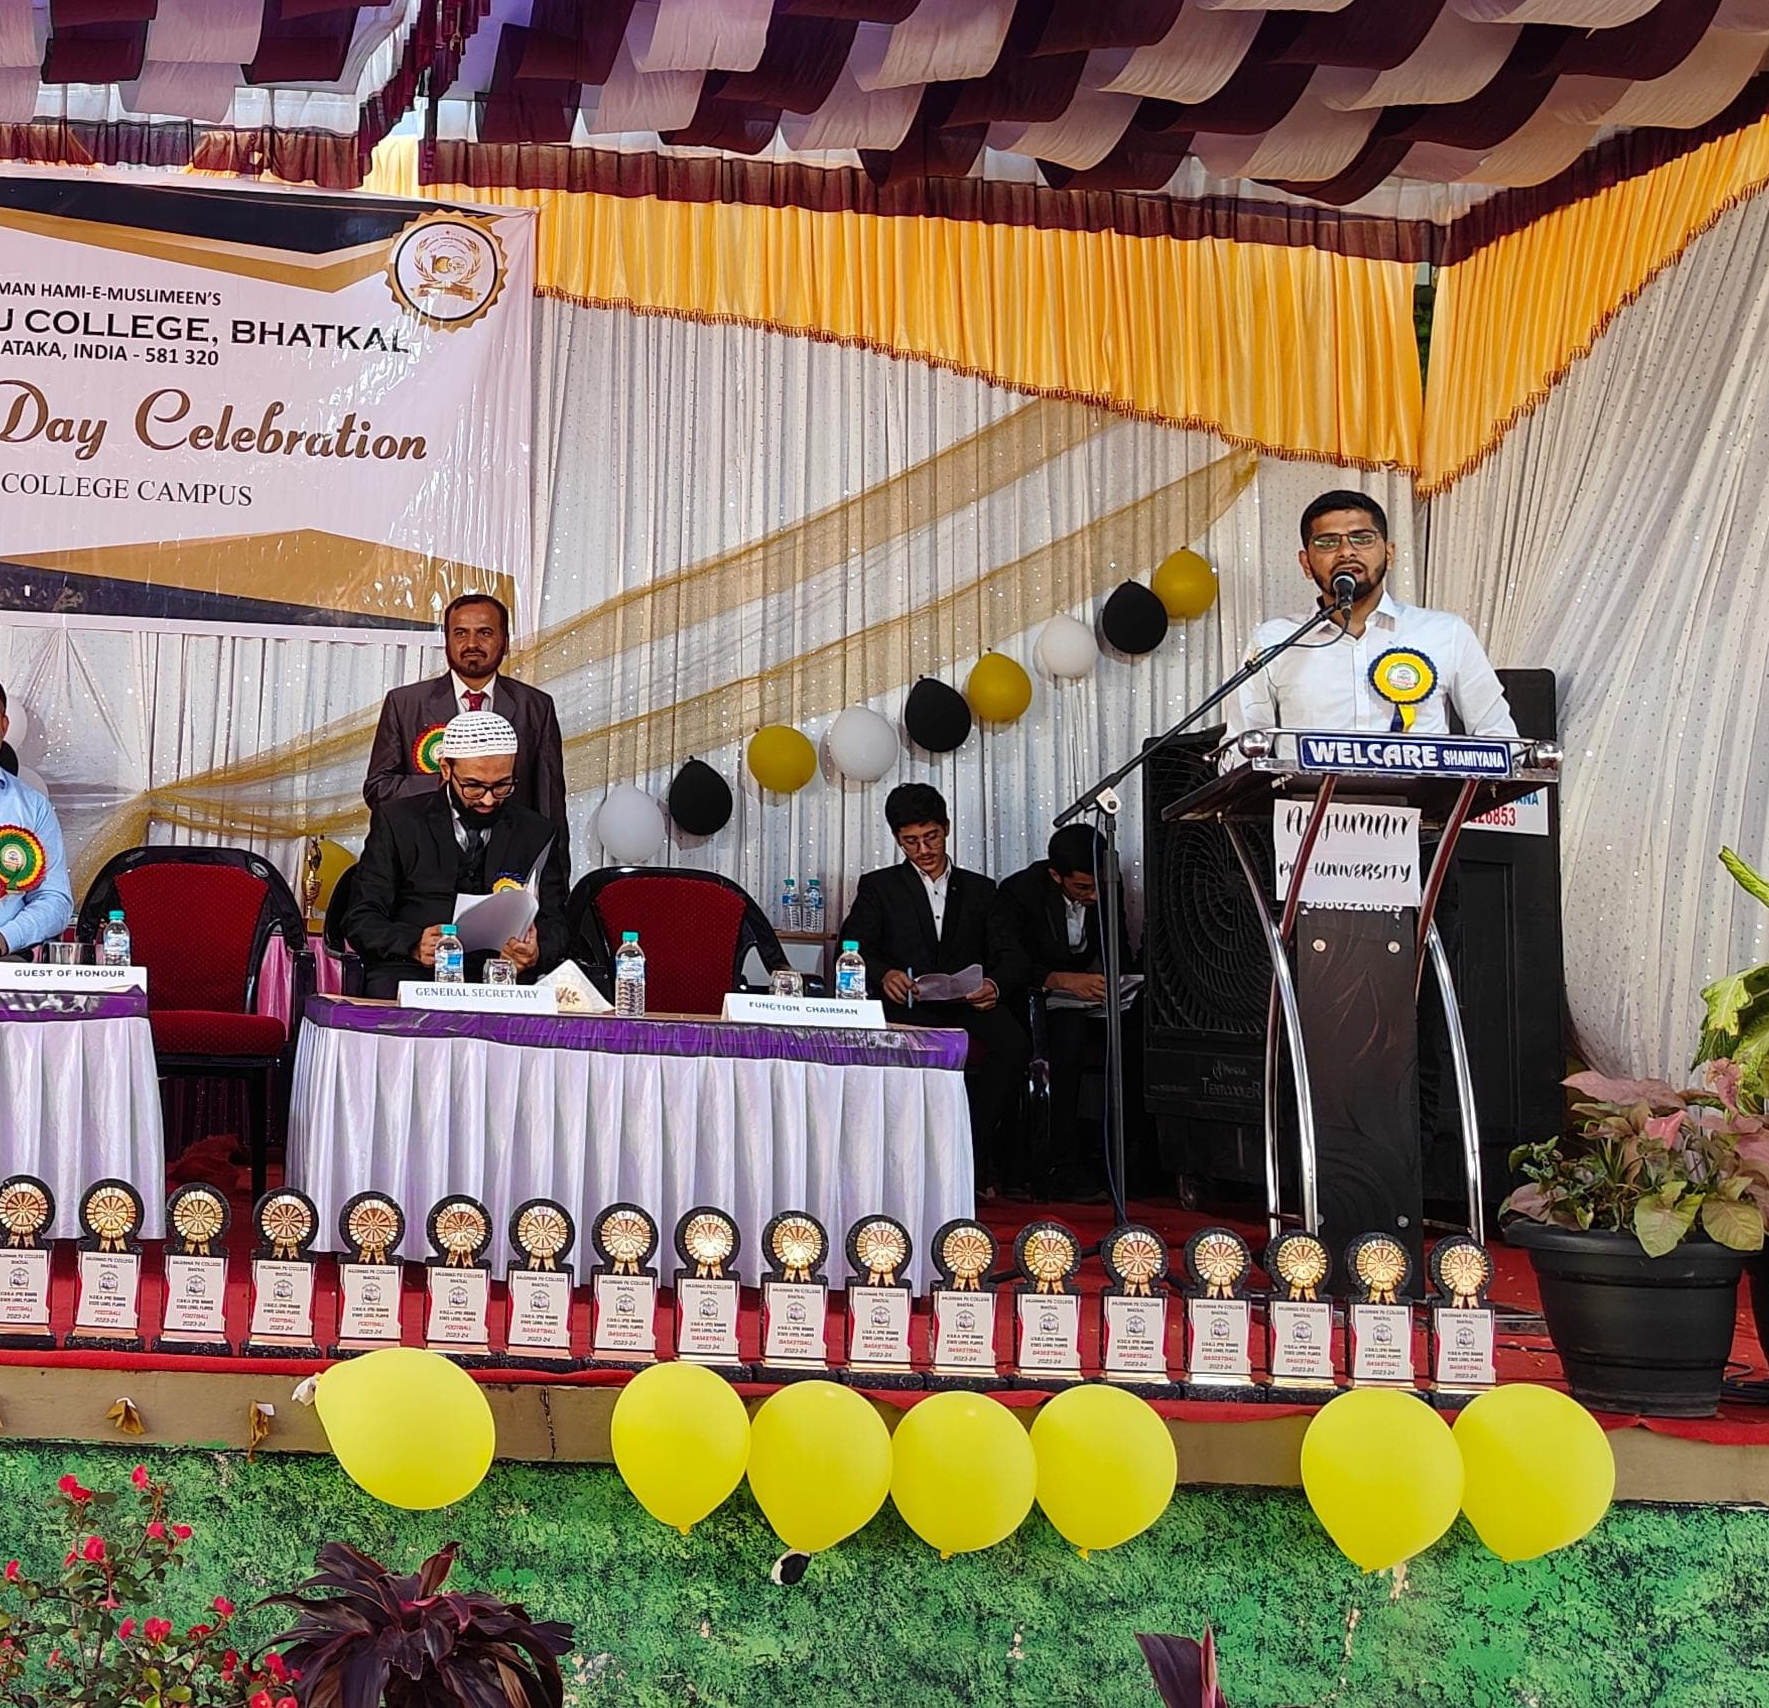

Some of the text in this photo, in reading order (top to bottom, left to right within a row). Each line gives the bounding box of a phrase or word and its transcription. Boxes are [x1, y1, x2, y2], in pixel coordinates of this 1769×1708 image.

[24, 309, 219, 347] COLLEGE,
[231, 319, 409, 353] BHATKAL
[74, 343, 127, 361] INDIA
[145, 347, 178, 364] 581
[185, 349, 219, 366] 320
[135, 388, 427, 460] Celebration
[1, 473, 129, 499] COLLEGE
[137, 480, 252, 507] CAMPUS
[1308, 740, 1505, 768] WELCARE SHAMIYANA
[14, 968, 126, 978] GUEST OF HONOUR
[415, 987, 539, 1000] GENERAL SECRETARY
[749, 1001, 859, 1016] FUNCTION CHAIRMAN
